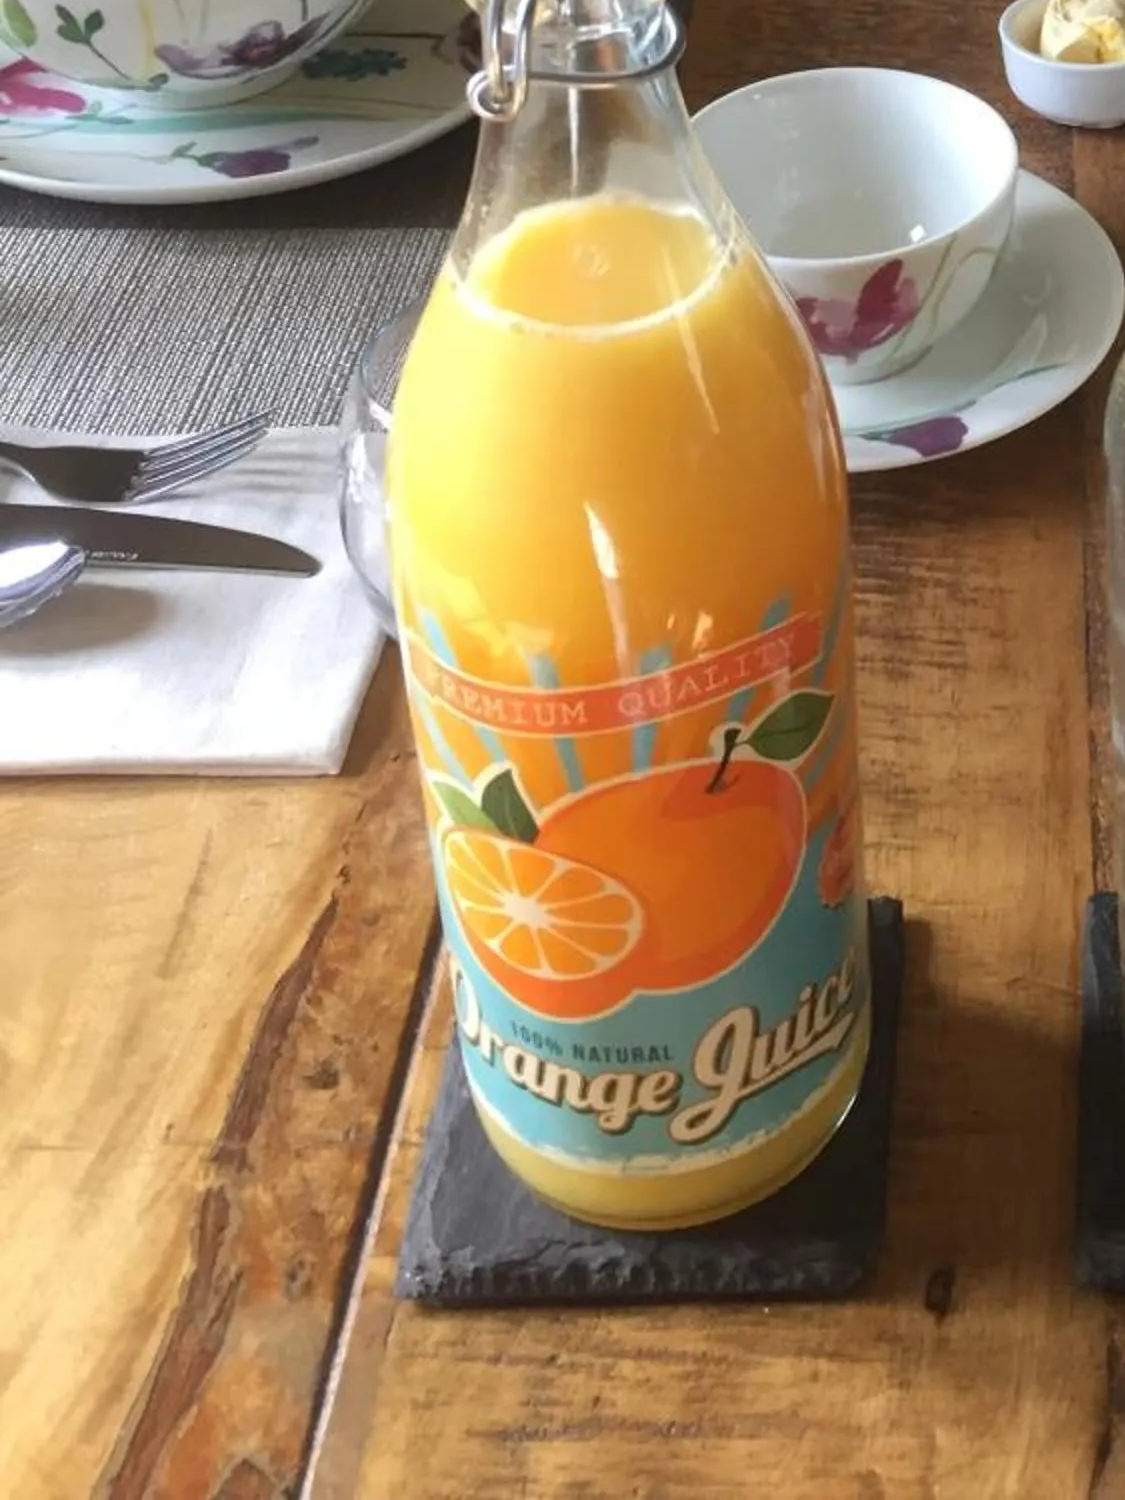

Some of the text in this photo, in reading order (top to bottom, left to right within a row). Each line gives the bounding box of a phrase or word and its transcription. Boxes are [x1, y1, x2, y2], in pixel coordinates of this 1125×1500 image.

[421, 634, 796, 727] PREMIUM QUALITY
[450, 958, 682, 1134] Orange
[510, 1020, 675, 1064] 100% NATURAL
